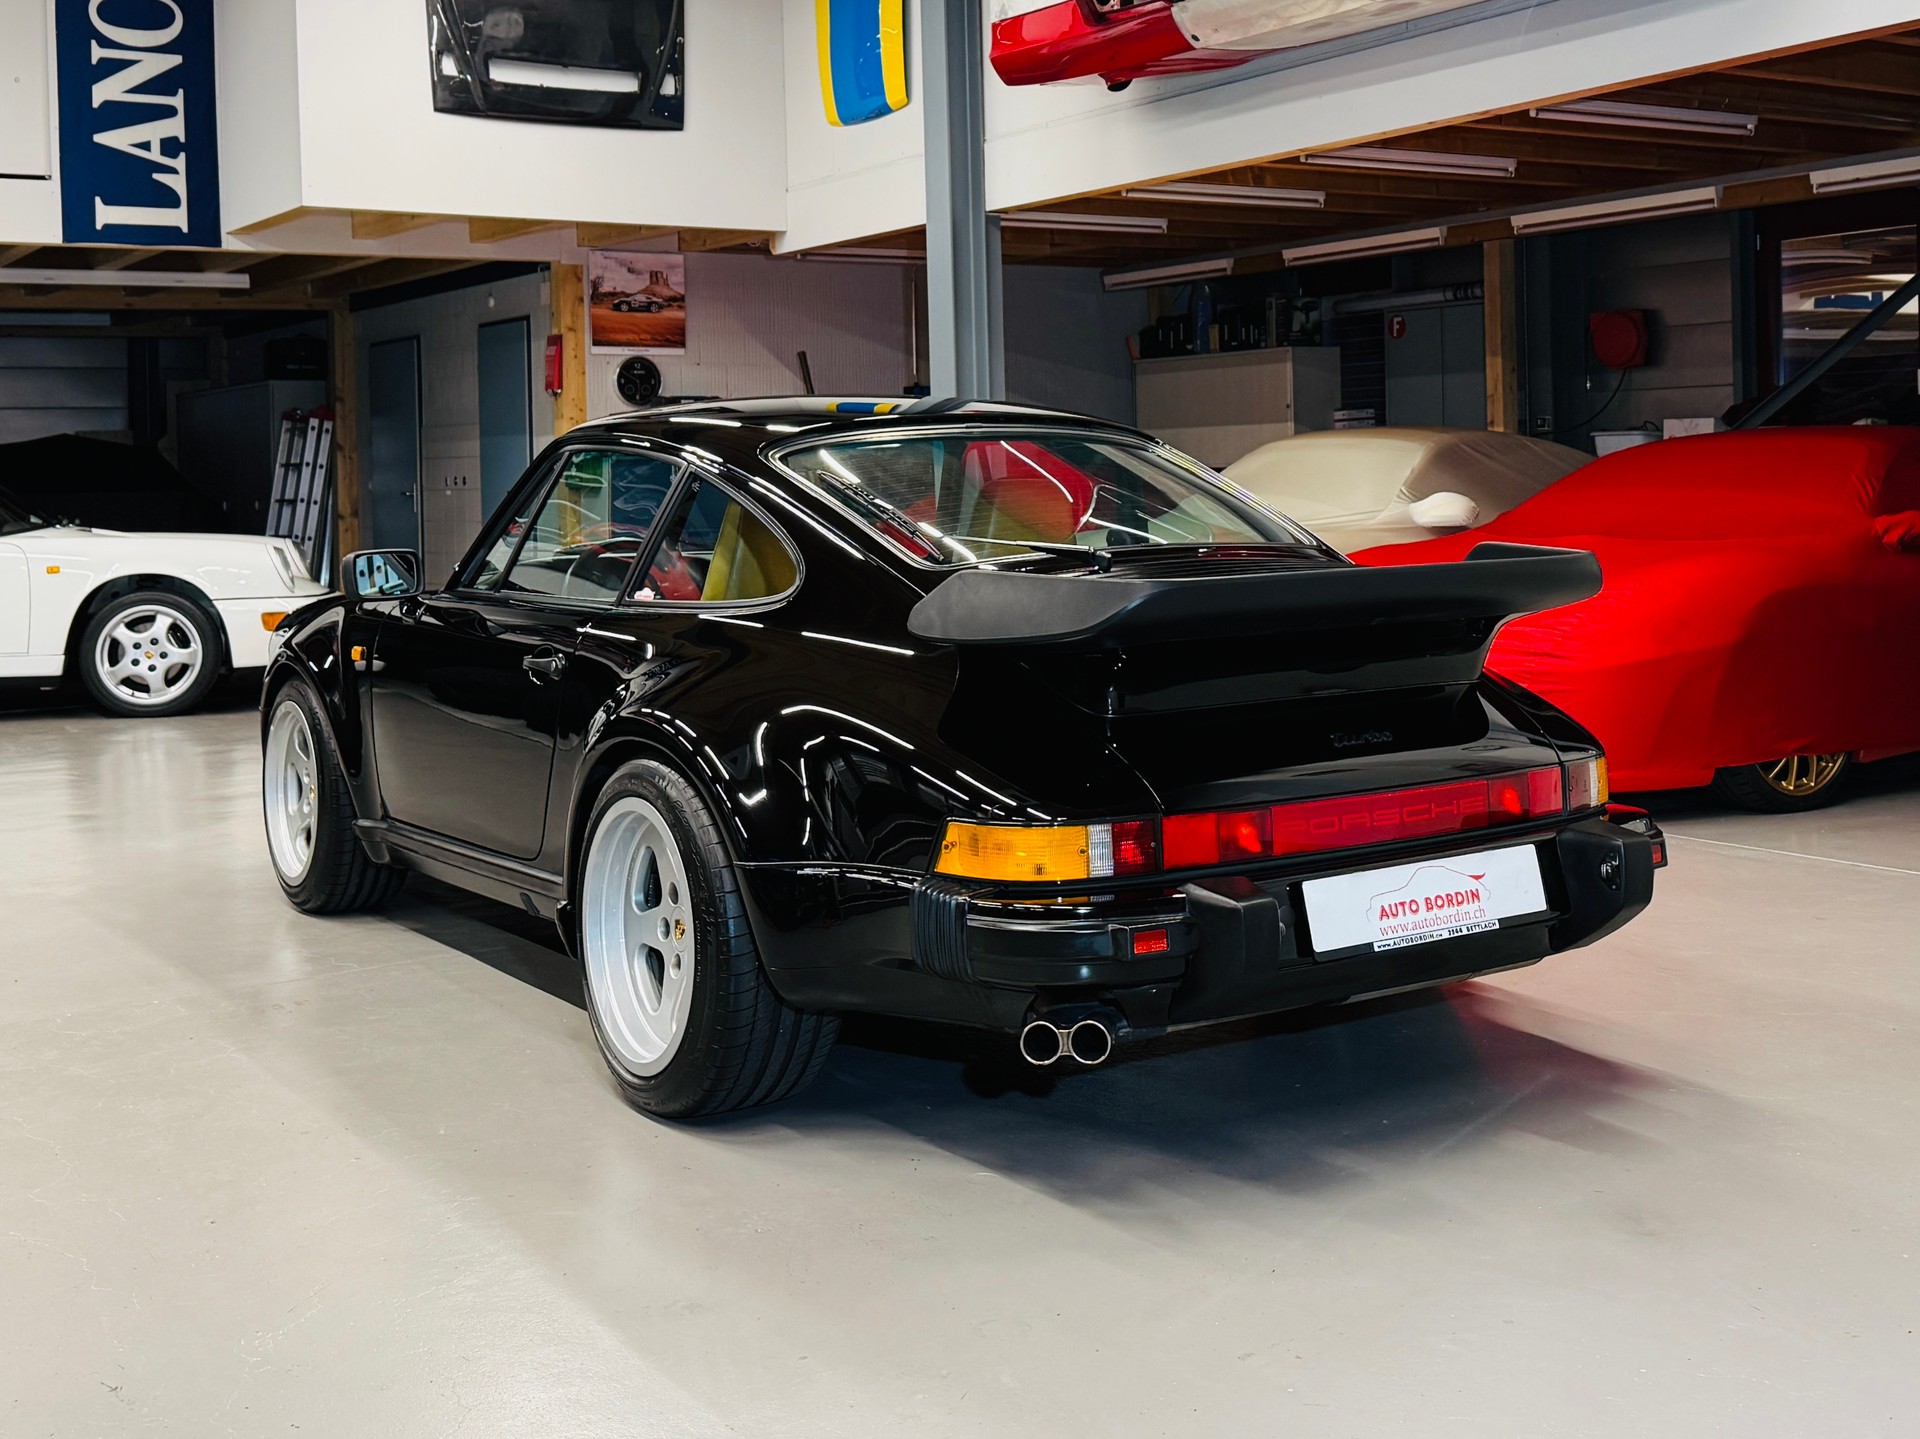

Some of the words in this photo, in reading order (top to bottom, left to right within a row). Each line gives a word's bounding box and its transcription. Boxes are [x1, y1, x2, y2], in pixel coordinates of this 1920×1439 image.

[1393, 317, 1403, 337] F
[1278, 797, 1486, 837] PORSCHE
[1379, 899, 1420, 921] AUTO
[1424, 888, 1481, 912] BORDIN
[1379, 904, 1486, 937] www.autobordin.ch
[1466, 921, 1497, 932] BETTLACH
